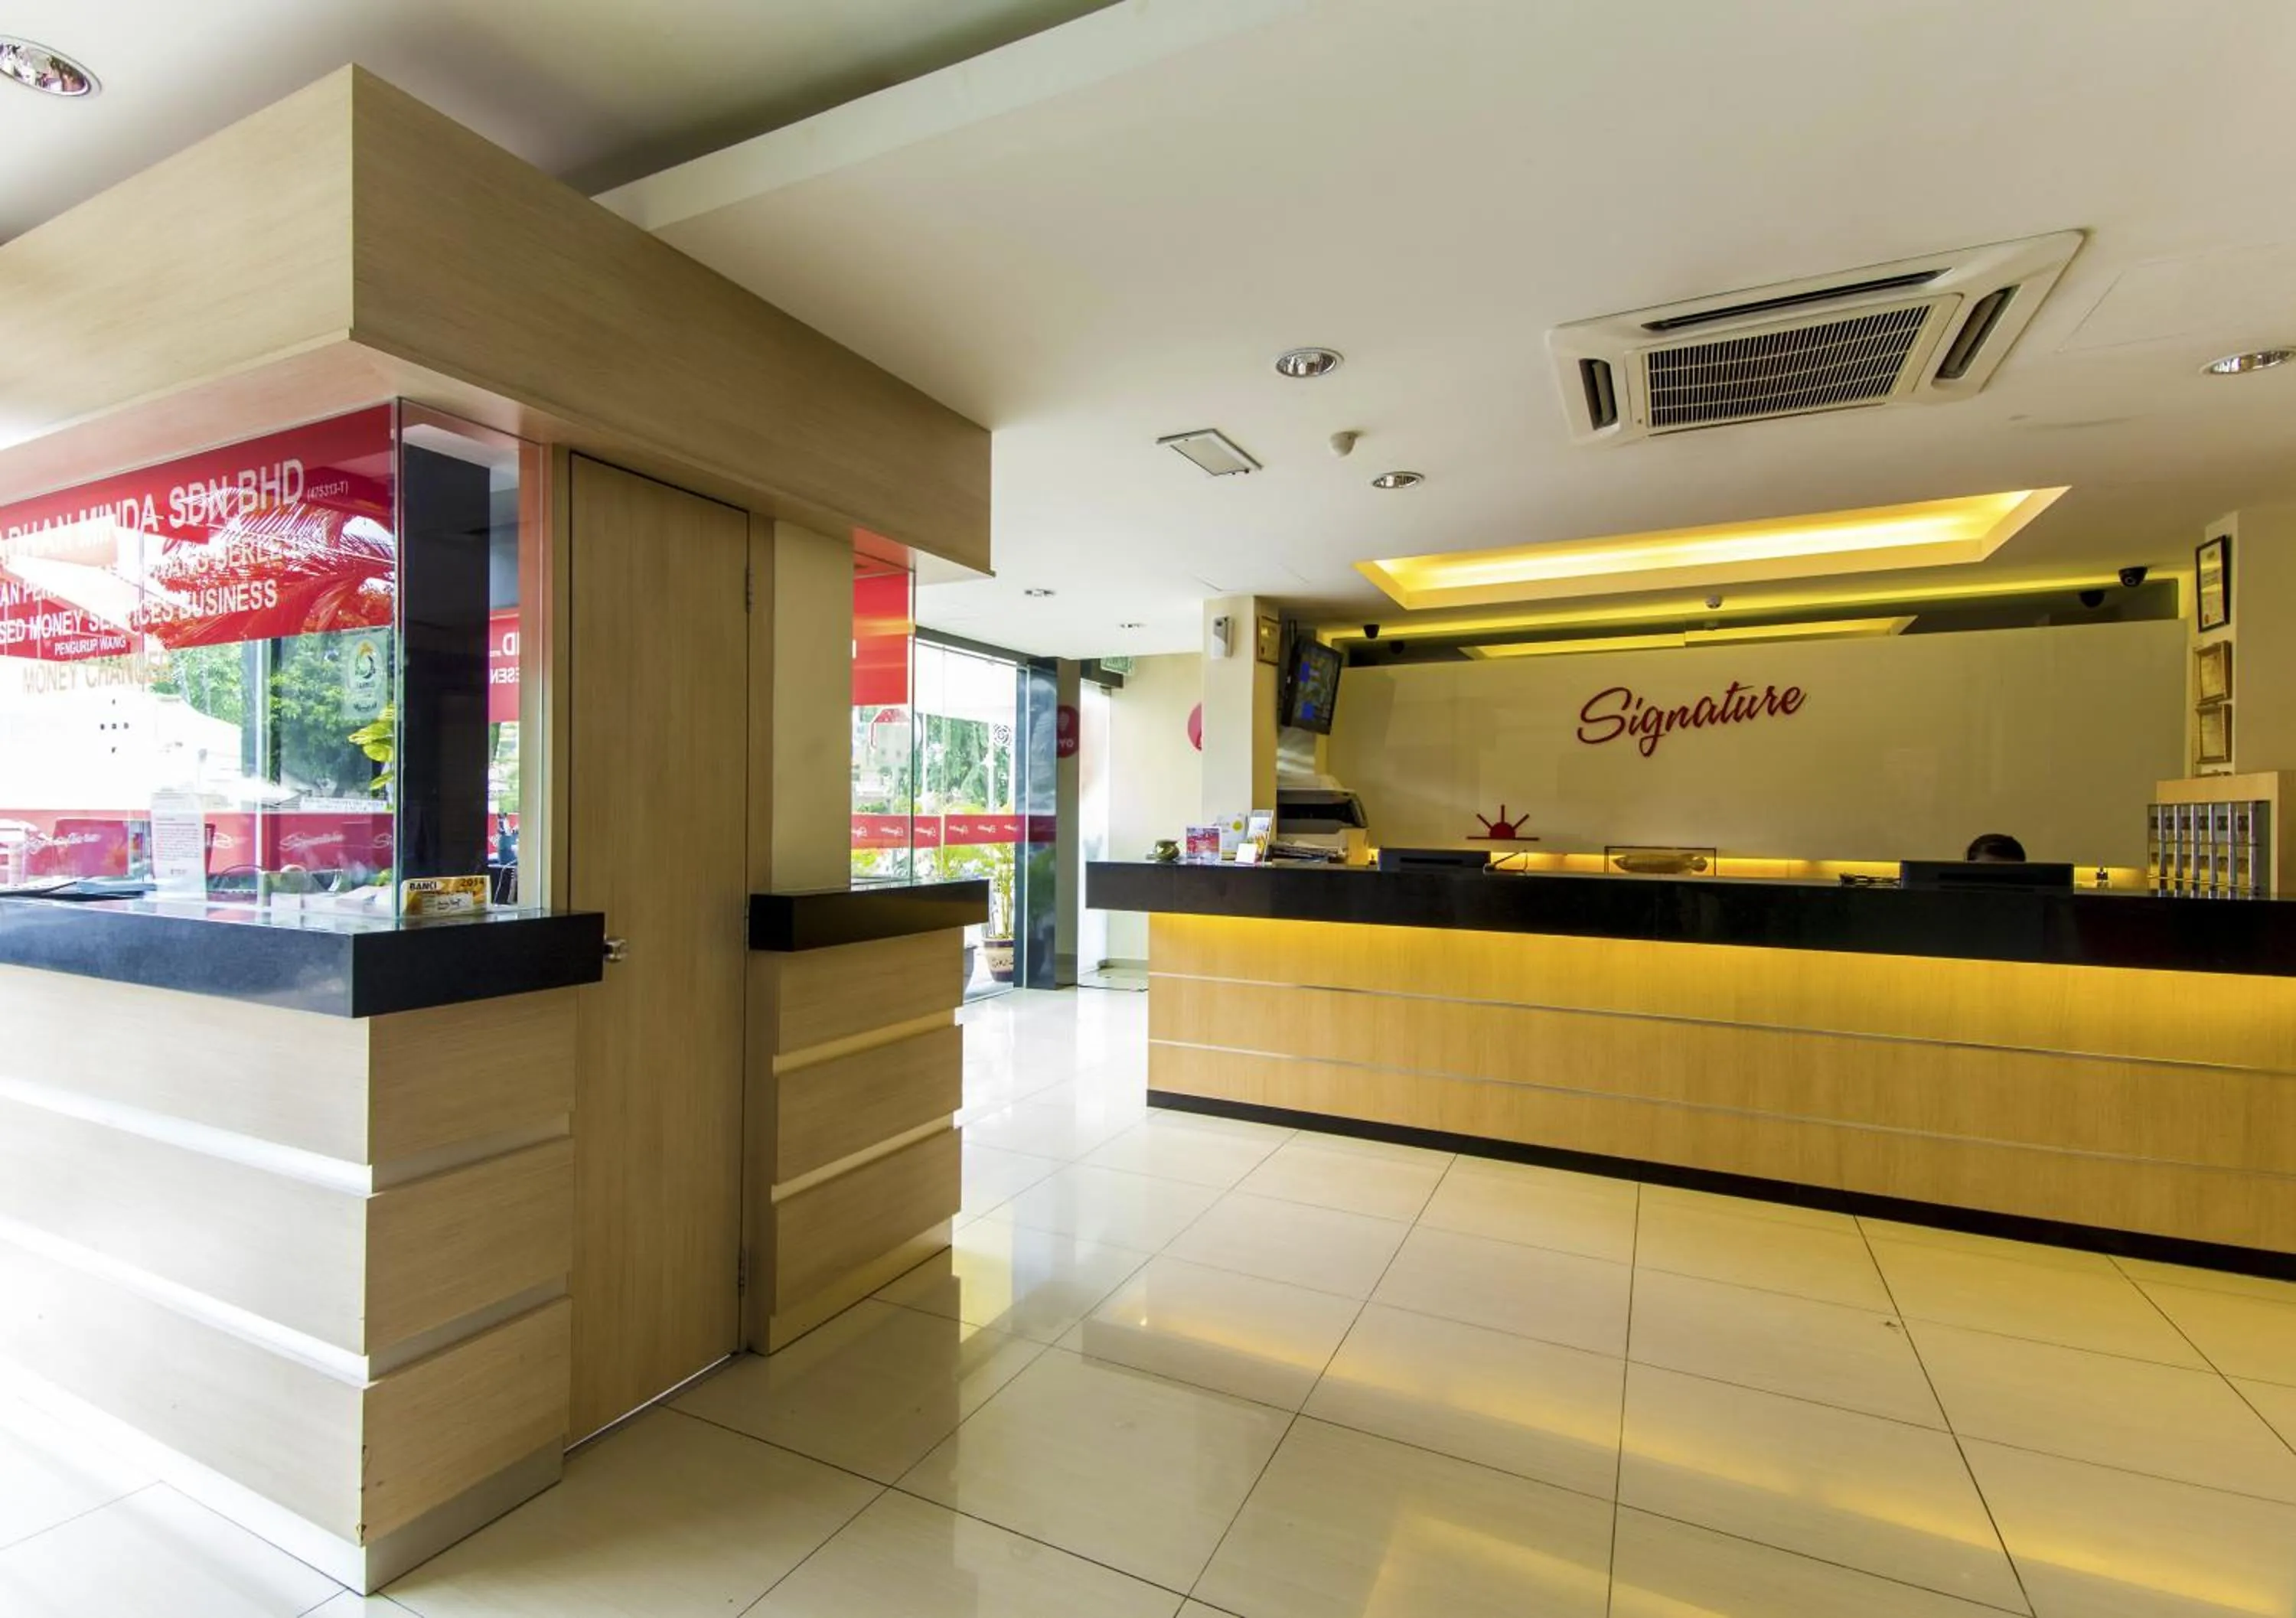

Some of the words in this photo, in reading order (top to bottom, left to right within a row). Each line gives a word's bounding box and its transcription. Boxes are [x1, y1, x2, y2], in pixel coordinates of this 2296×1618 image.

[168, 475, 227, 529] SDN
[237, 458, 304, 515] BHD
[29, 609, 82, 640] MONEY
[180, 579, 277, 620] BUSINESS
[54, 637, 98, 656] PENGURUP
[99, 634, 126, 650] WANG
[23, 663, 78, 694] MONEY
[1577, 680, 1808, 757] Signature
[409, 881, 437, 891] BANCI
